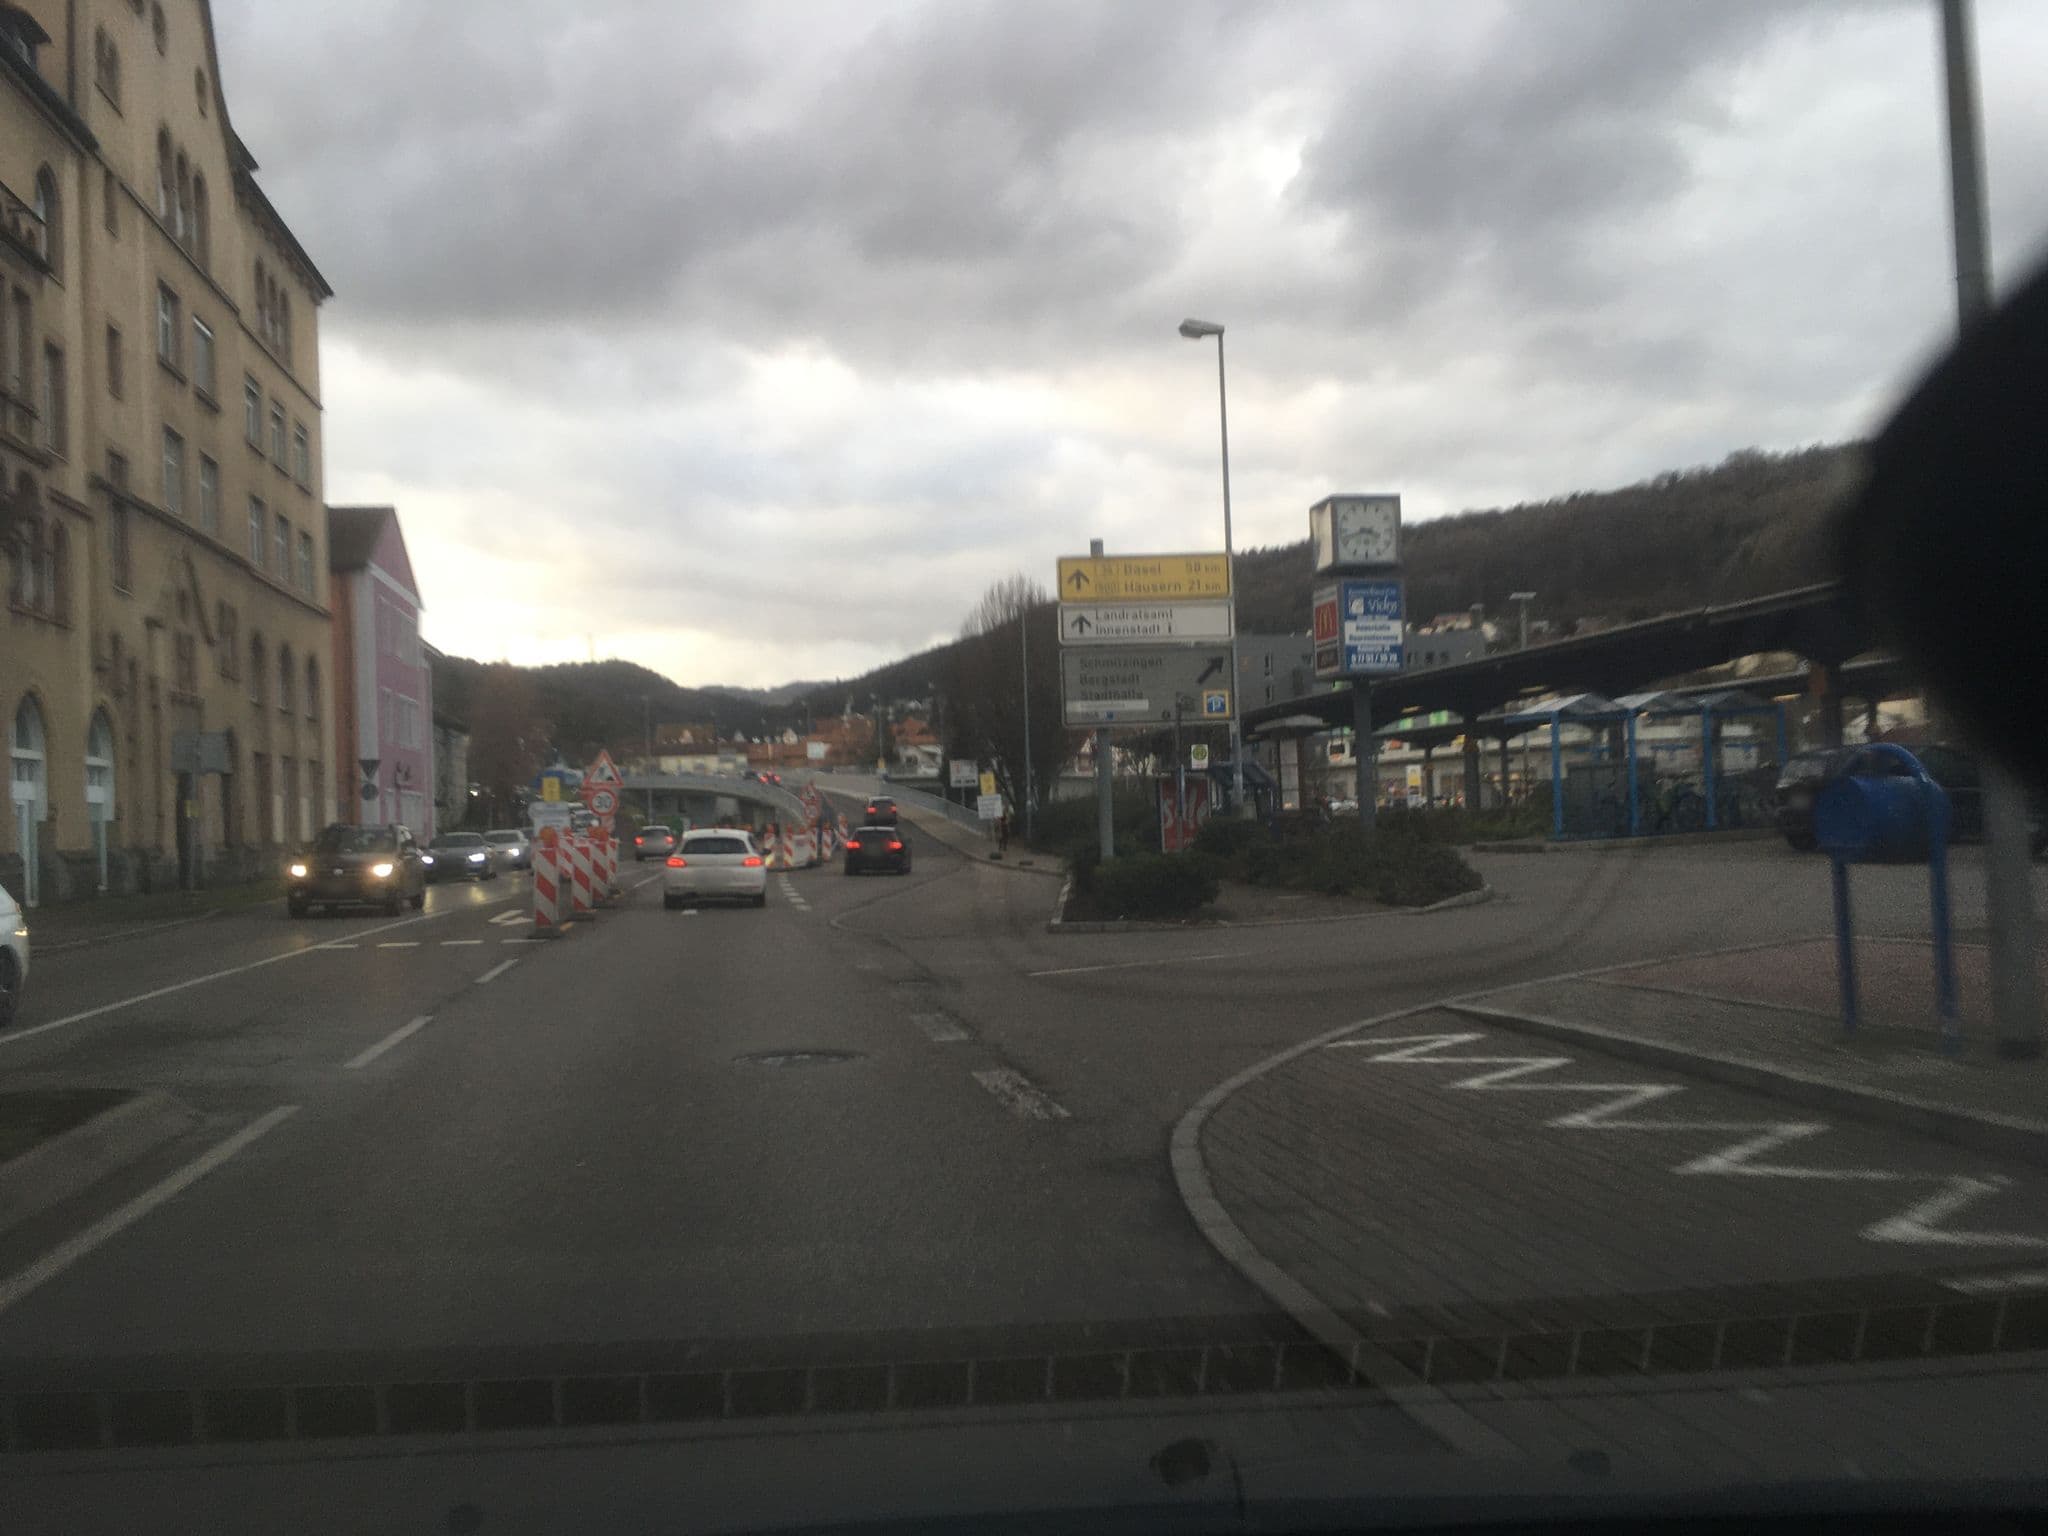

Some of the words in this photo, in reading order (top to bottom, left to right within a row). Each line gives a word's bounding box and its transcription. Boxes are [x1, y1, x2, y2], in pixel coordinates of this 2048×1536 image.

[1124, 563, 1161, 576] Basel
[1205, 563, 1221, 574] km
[1187, 579, 1201, 591] 21
[1204, 582, 1221, 592] km
[1095, 608, 1173, 620] Landratsamt
[1095, 623, 1161, 635] Innenstadt
[595, 795, 613, 809] 30
